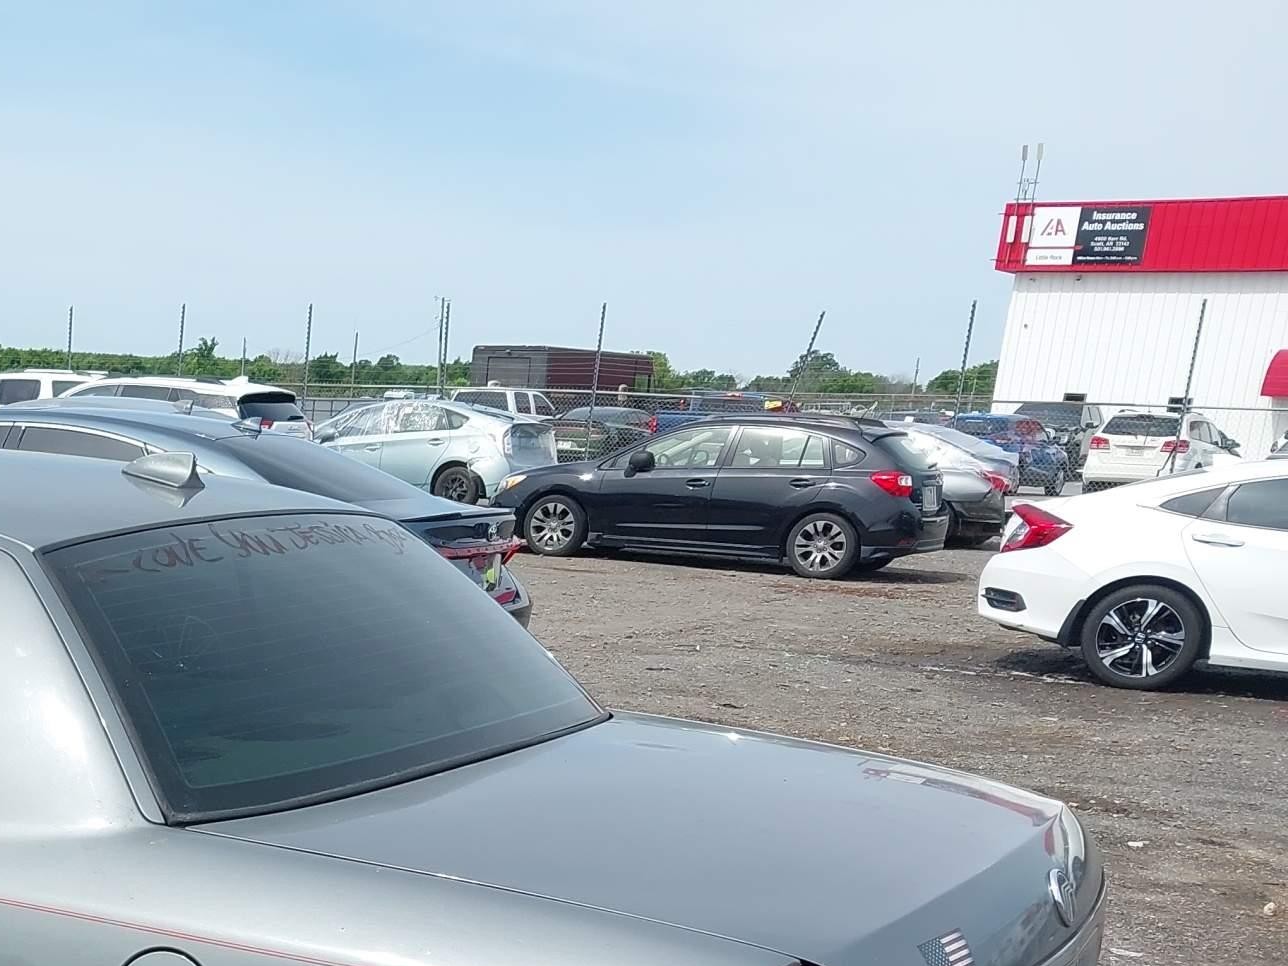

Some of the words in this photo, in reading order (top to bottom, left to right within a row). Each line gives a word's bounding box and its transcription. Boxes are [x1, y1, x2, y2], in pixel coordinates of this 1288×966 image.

[1092, 211, 1137, 220] Insurance
[1081, 221, 1103, 231] Auto
[1104, 221, 1145, 231] Auctions
